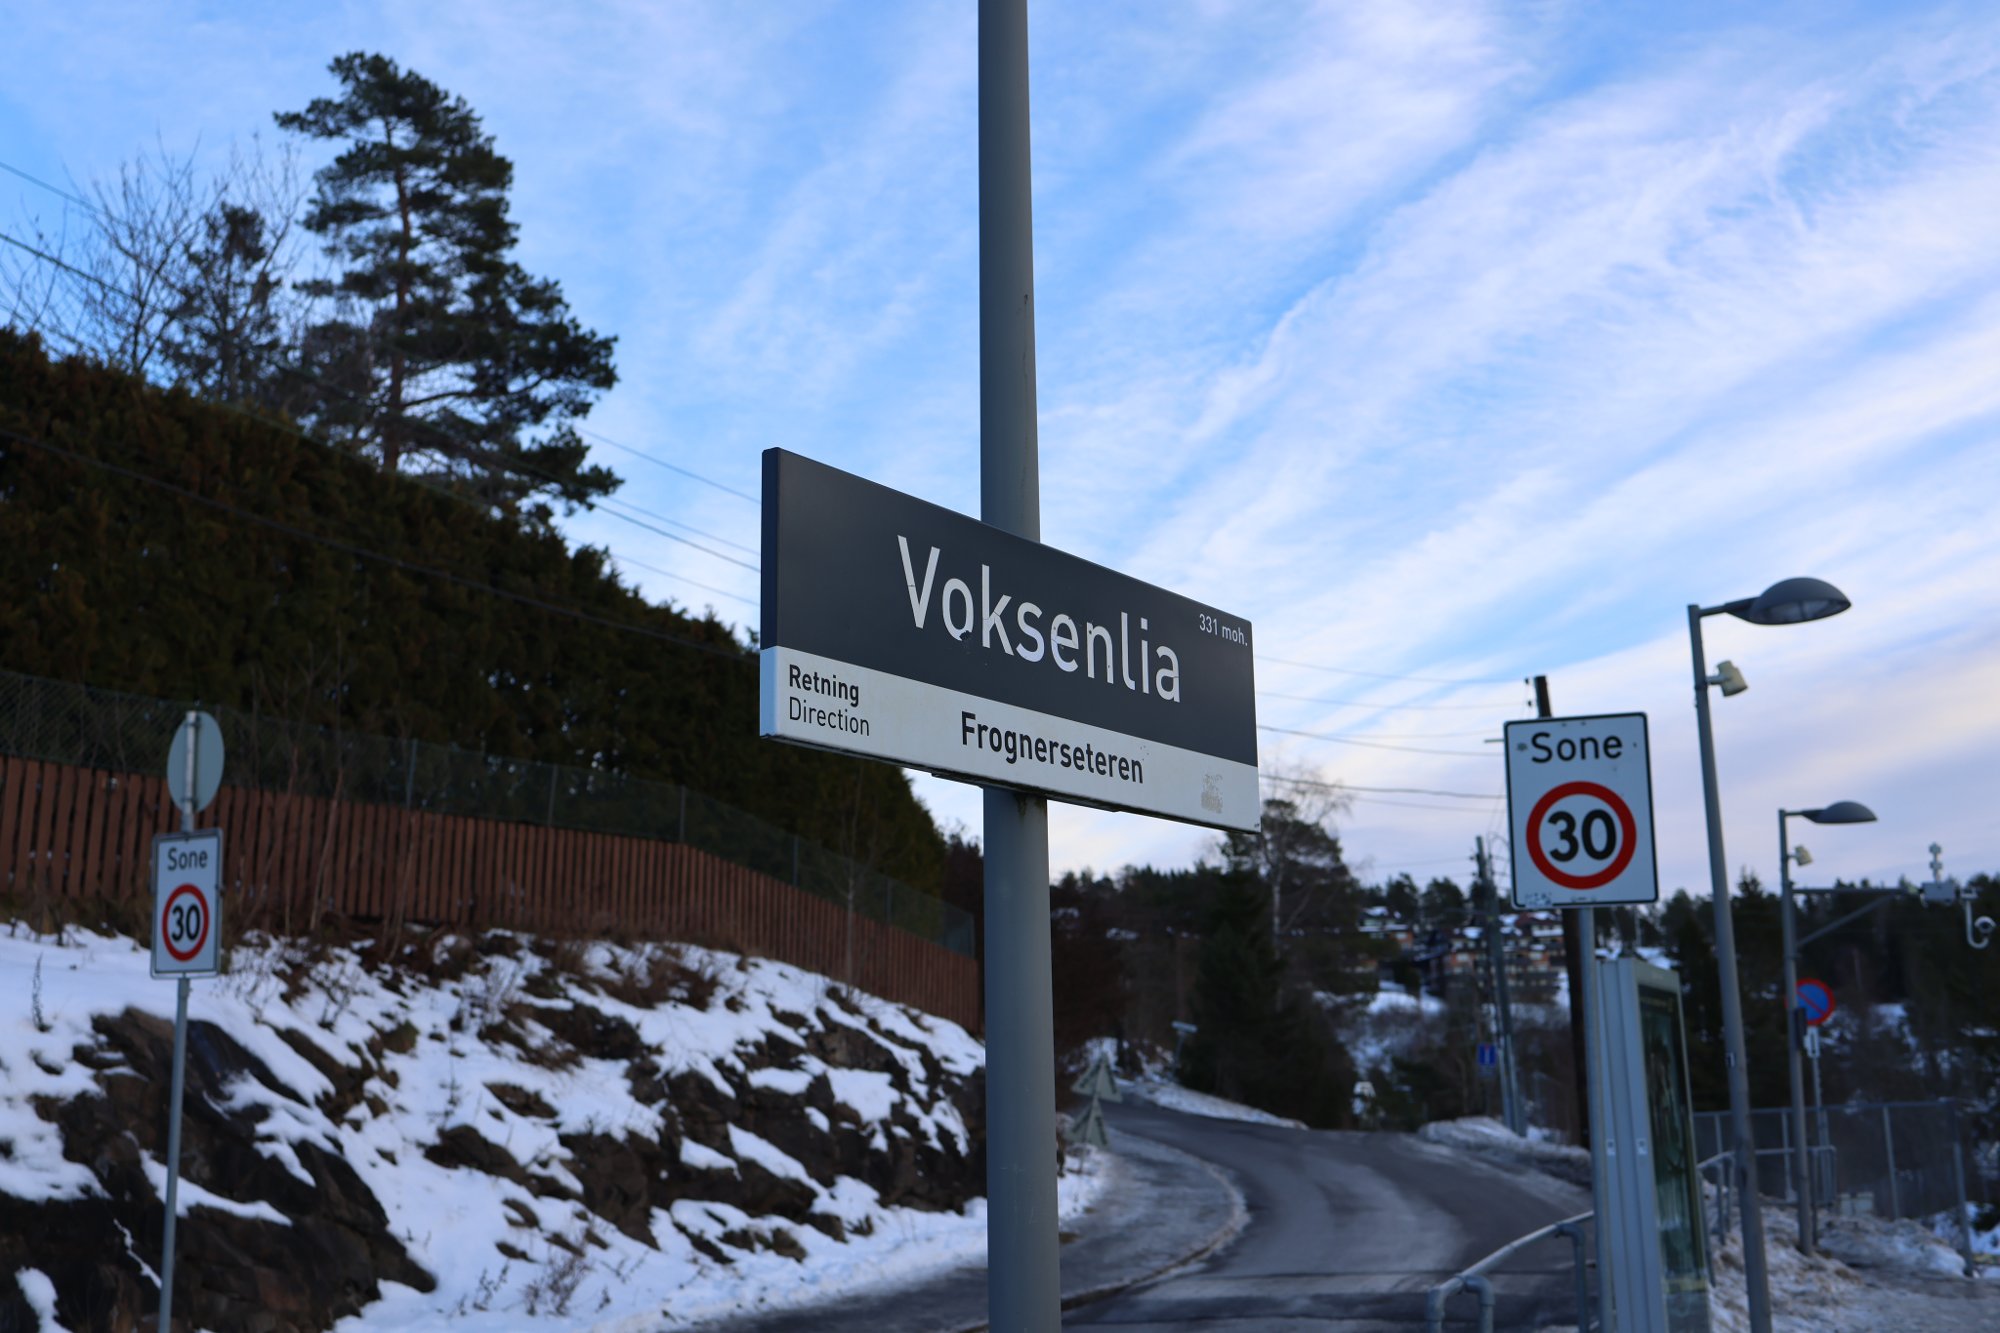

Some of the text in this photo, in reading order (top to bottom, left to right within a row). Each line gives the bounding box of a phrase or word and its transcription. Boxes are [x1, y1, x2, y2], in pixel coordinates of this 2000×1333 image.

[897, 534, 1181, 702] Voksenlia
[1199, 613, 1248, 647] 331 moh.
[789, 664, 859, 707] Retning
[789, 697, 869, 736] Direction
[961, 711, 1143, 784] Frognerseteren
[1531, 732, 1623, 763] Sone
[1547, 808, 1617, 862] 30
[167, 847, 208, 871] Sone
[171, 904, 202, 942] 30
